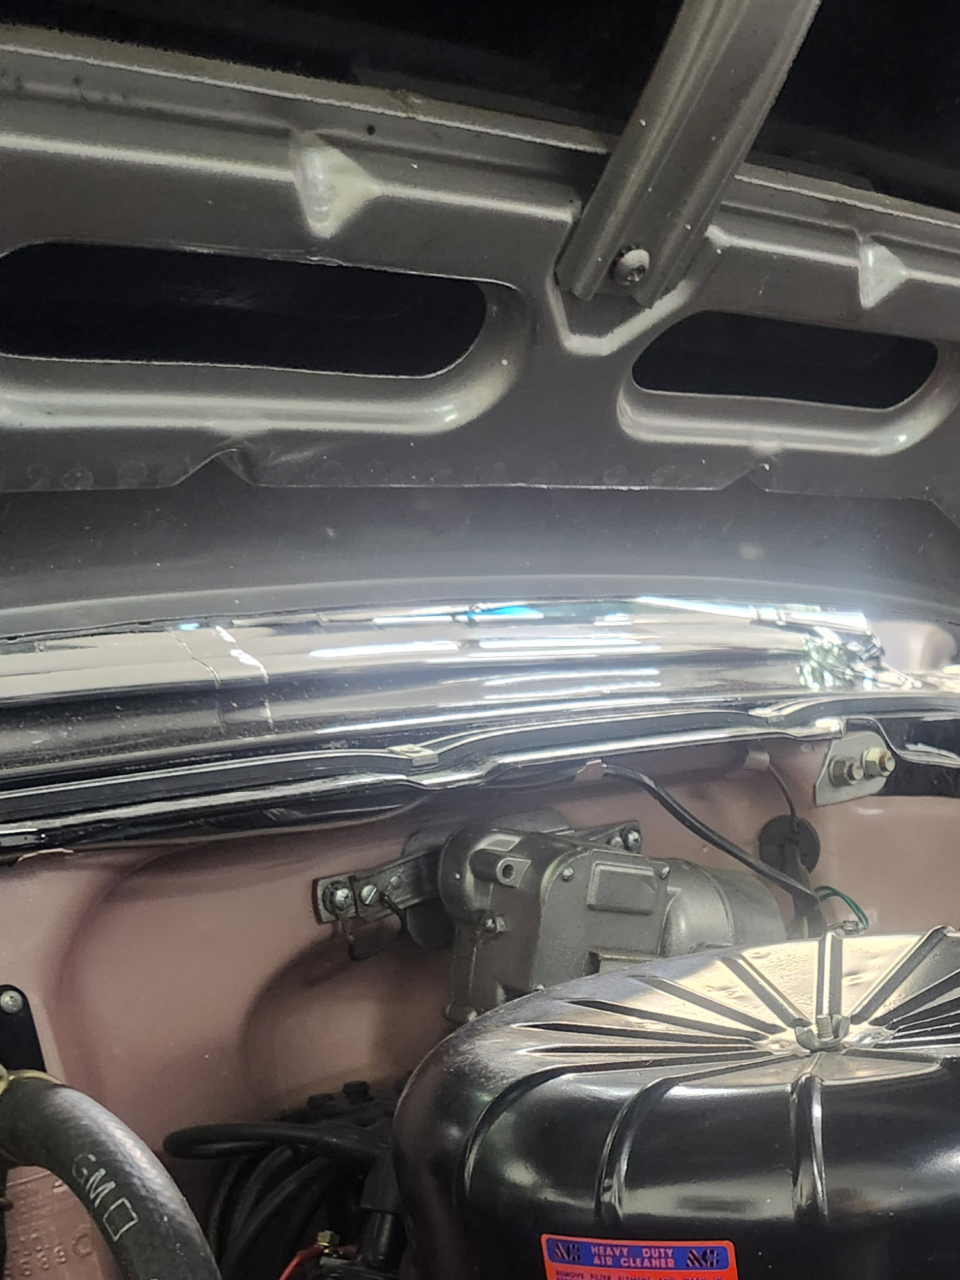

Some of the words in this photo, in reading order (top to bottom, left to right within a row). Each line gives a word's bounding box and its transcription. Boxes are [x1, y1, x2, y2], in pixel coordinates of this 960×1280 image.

[591, 1246, 628, 1256] HEAVY
[642, 1248, 673, 1257] DUTY
[594, 1257, 613, 1266] AIR
[620, 1258, 675, 1268] CLEANER
[686, 1248, 719, 1268] AC
